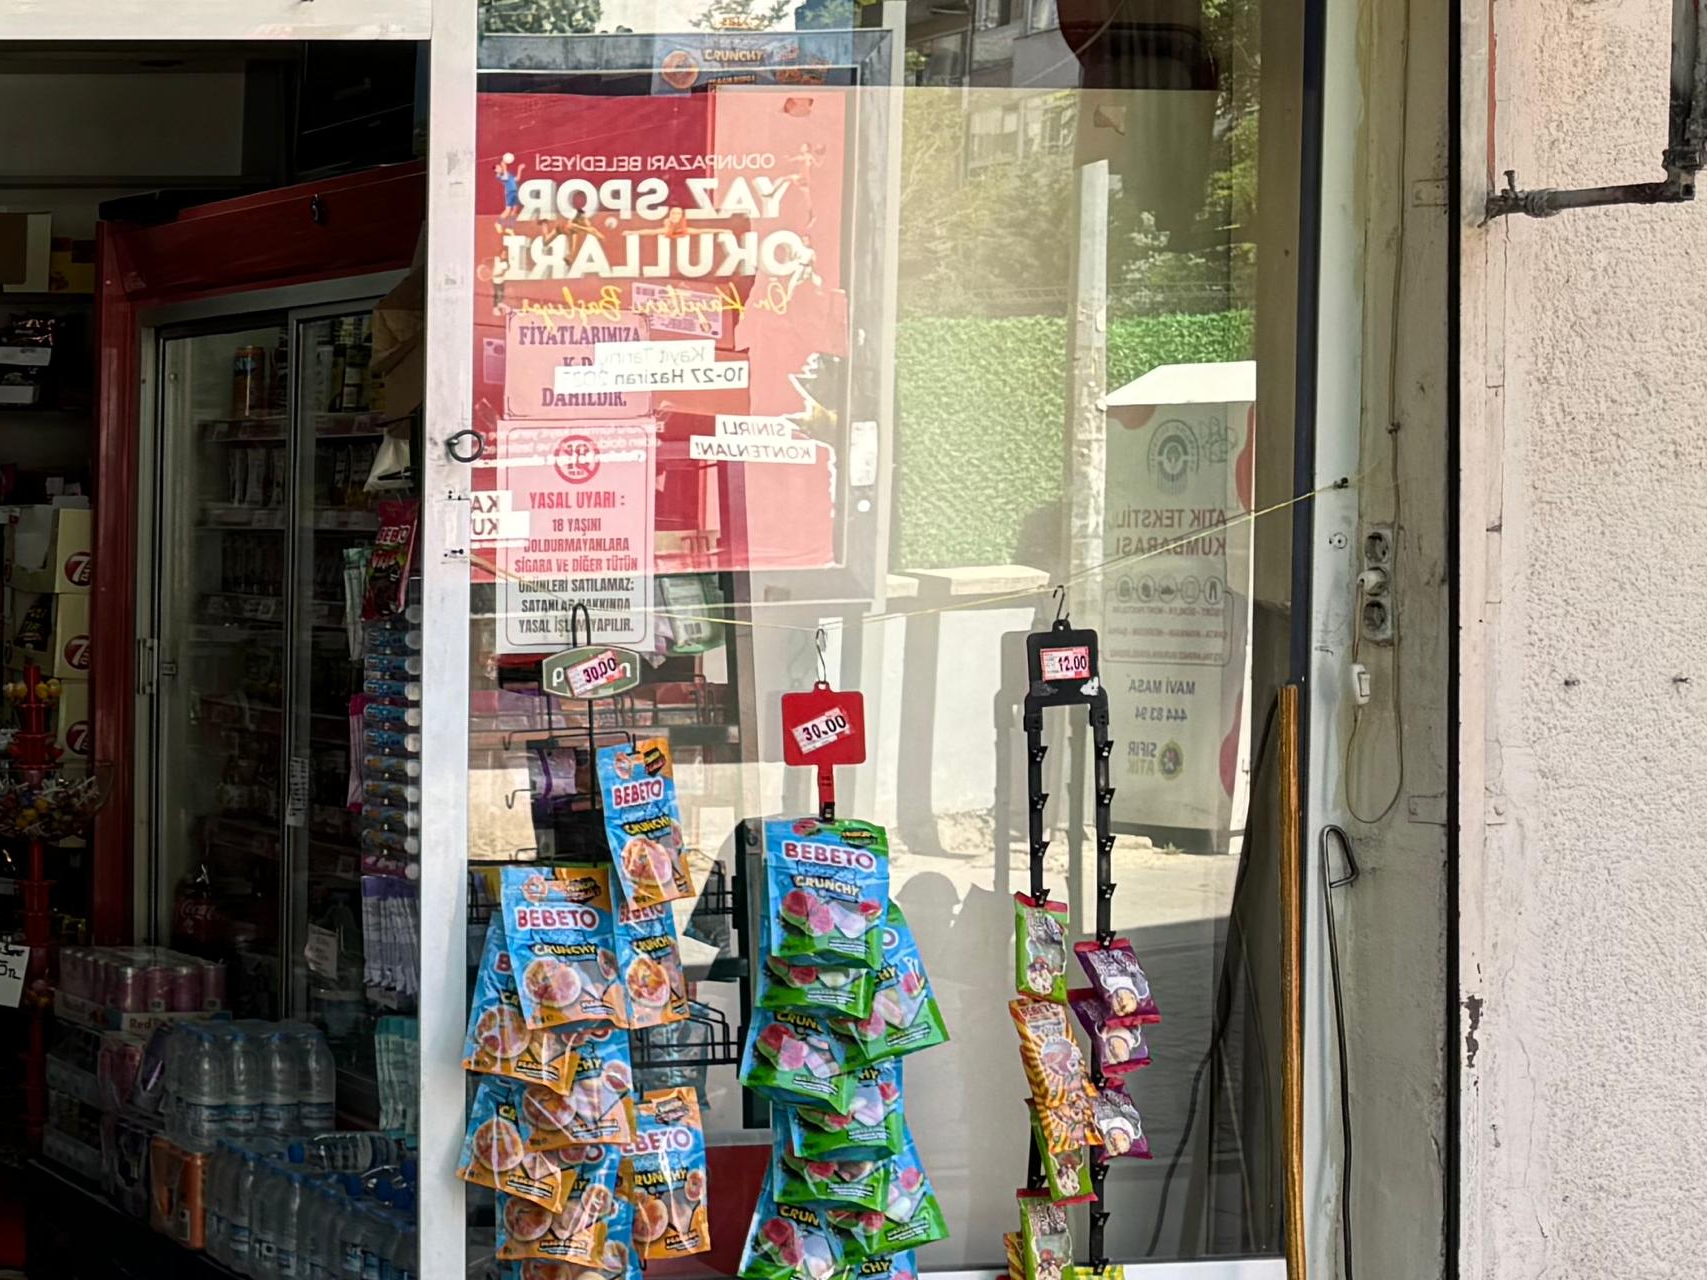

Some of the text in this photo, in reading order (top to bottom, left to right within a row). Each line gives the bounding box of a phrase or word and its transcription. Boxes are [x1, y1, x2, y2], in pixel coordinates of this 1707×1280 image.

[703, 48, 763, 62] CRUNCHY
[530, 492, 571, 508] YASAL
[577, 492, 615, 508] UYARI
[552, 517, 601, 536] 18 YAŞINI
[524, 537, 629, 553] DOLDURMAYANLARA
[515, 554, 637, 572] SİGARA VE DİĞER TÜTÜN
[522, 598, 575, 613] SATANLAR
[519, 619, 551, 634] YASAL
[555, 616, 587, 637] İŞLM
[1058, 655, 1087, 672] 12.00
[612, 779, 663, 808] BEBETO
[784, 841, 875, 871] BEBETO
[794, 874, 860, 897] CRUNCHY
[516, 907, 598, 931] BEBETO
[533, 942, 598, 956] CRUNCHY
[620, 1127, 691, 1156] EBETO
